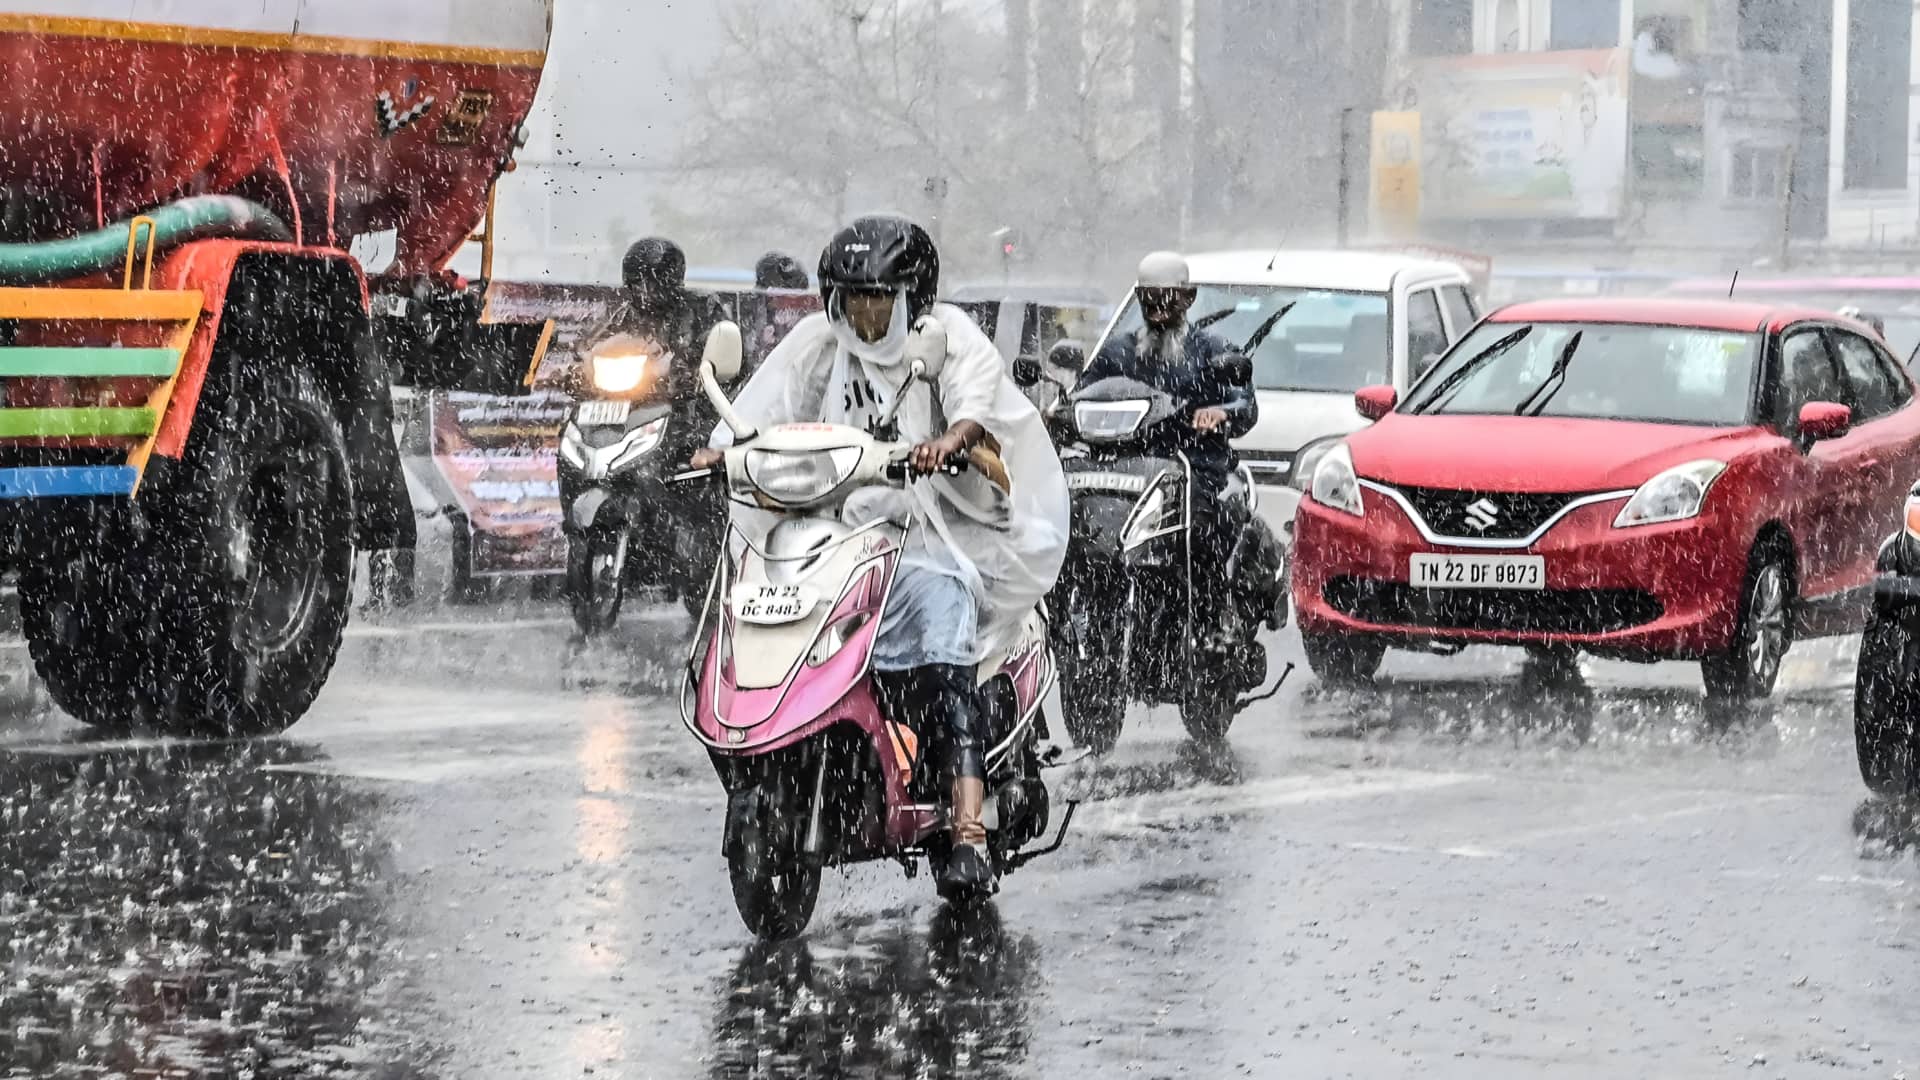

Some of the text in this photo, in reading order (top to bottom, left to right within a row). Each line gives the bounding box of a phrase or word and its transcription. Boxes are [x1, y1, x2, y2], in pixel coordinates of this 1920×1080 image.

[1420, 562, 1439, 582] TN
[1445, 562, 1464, 582] 22
[1471, 564, 1491, 583] DF
[758, 585, 800, 598] TN 22
